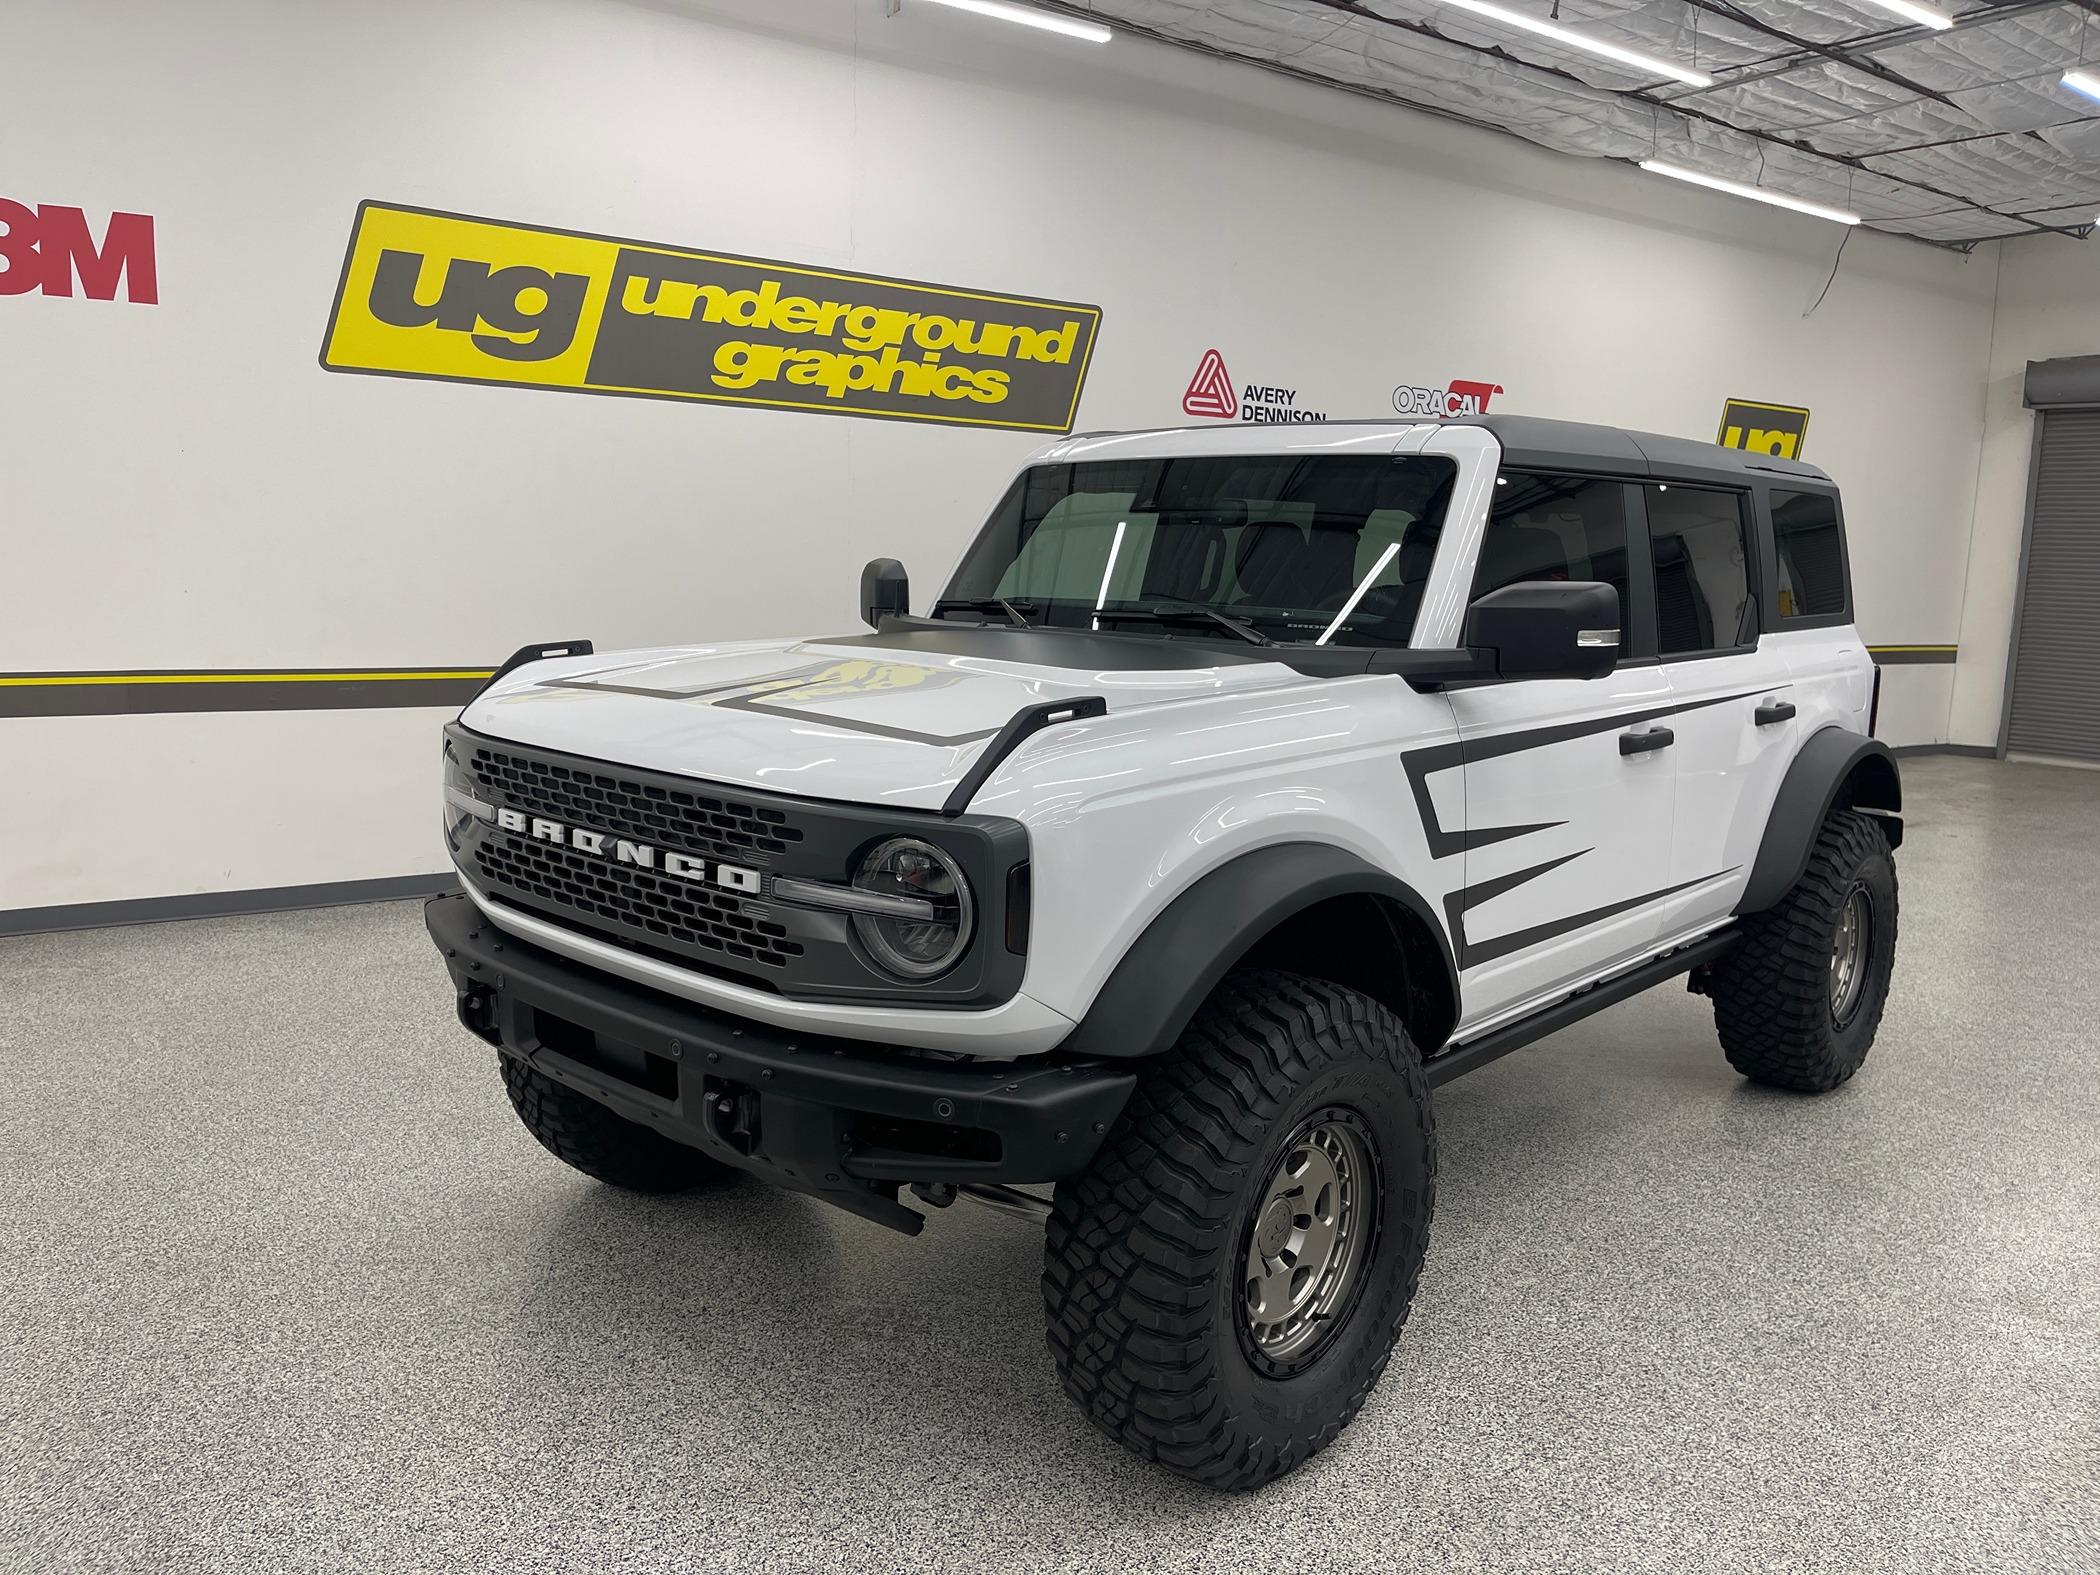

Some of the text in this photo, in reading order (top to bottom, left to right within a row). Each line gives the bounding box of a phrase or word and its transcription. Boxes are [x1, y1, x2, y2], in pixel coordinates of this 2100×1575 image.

[368, 248, 590, 362] ug
[621, 274, 1081, 364] underground
[711, 339, 1011, 404] graphics
[1243, 384, 1297, 406] AVERY
[1392, 385, 1489, 418] ORACAL
[1287, 623, 1354, 632] BRONO
[497, 807, 762, 894] BRONCO
